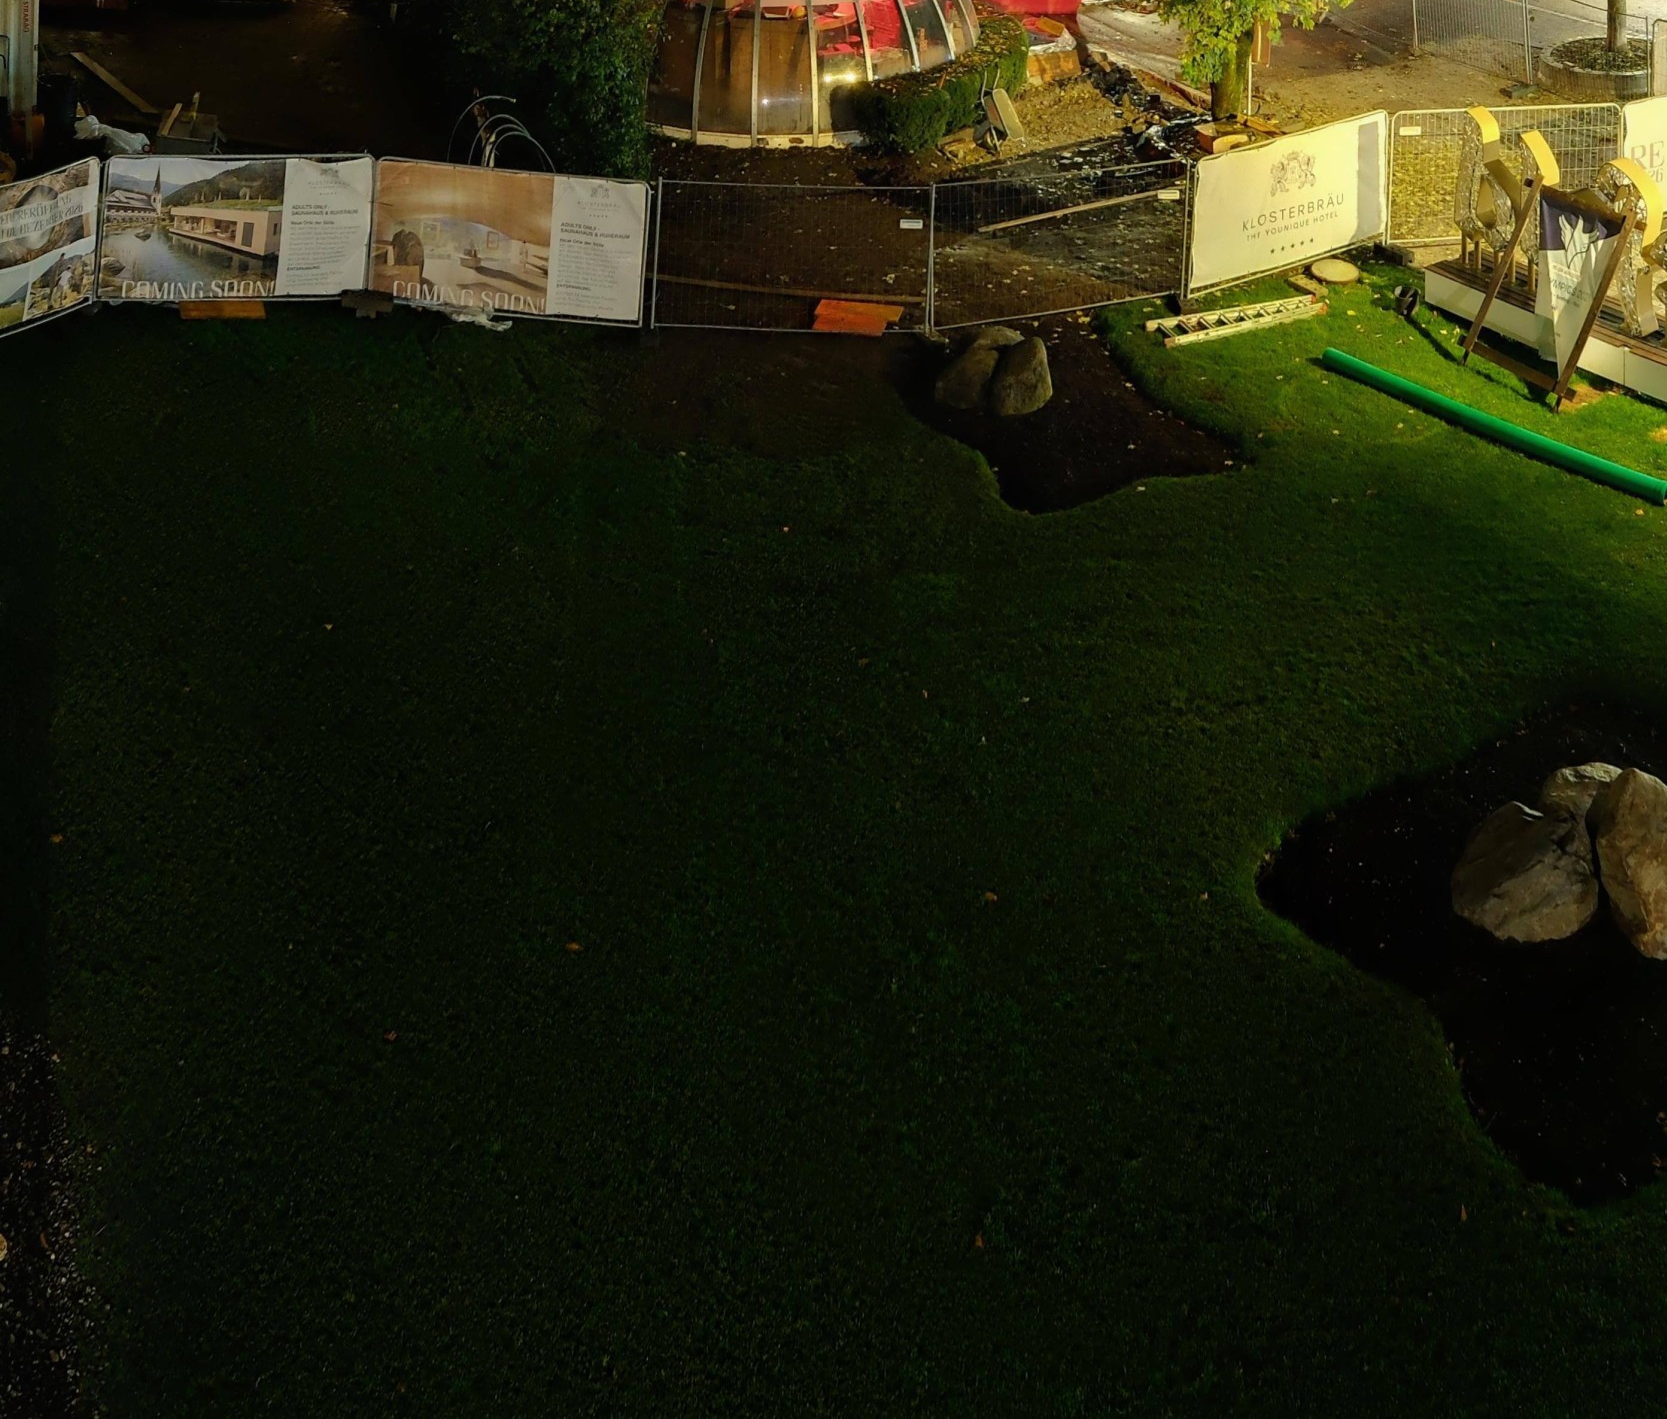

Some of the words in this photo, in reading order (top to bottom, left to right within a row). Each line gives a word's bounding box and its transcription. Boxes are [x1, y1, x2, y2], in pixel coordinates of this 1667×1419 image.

[1242, 191, 1345, 233] KLOSTERBRÄU
[1246, 232, 1262, 242] THE
[1265, 220, 1310, 238] YOUNIQUE
[1313, 210, 1340, 226] HOTEL
[121, 280, 204, 299] COMING
[209, 279, 277, 298] SOON!
